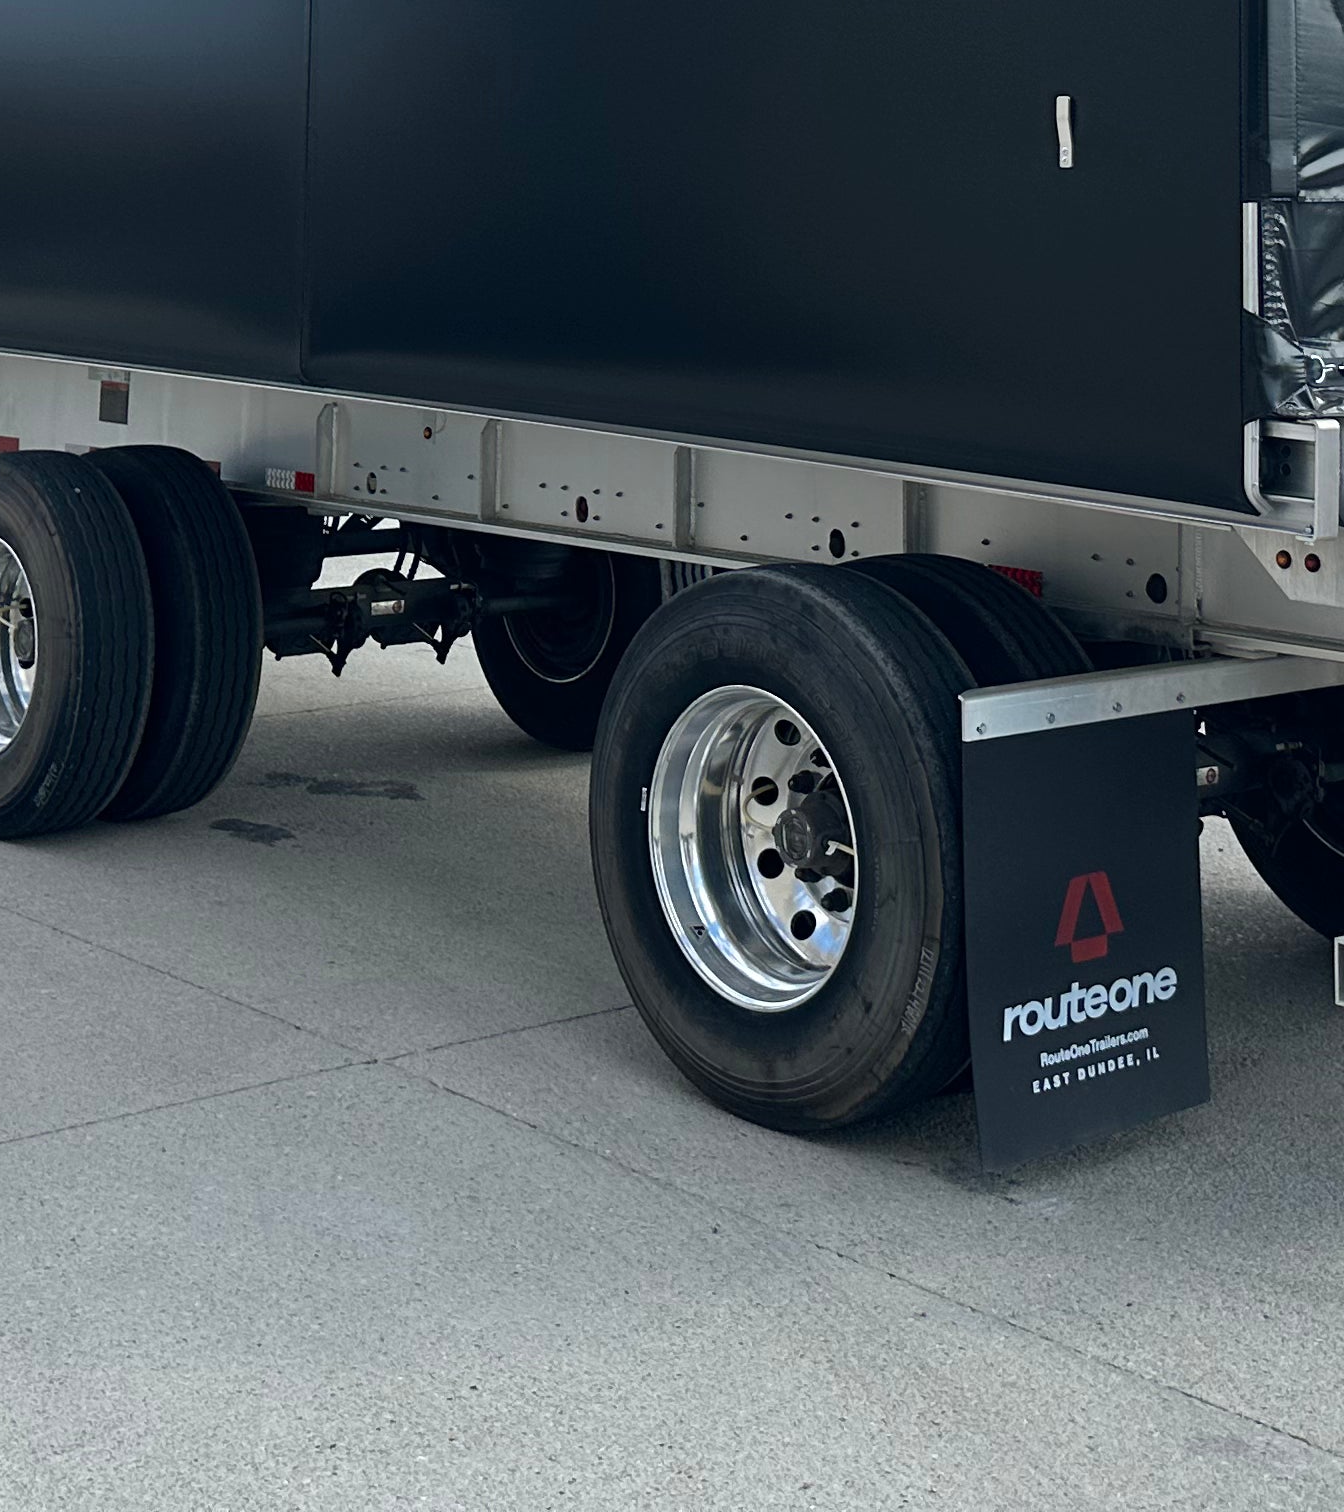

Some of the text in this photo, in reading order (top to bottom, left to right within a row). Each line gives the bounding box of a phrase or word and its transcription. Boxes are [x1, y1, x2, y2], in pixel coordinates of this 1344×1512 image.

[1003, 966, 1178, 1042] routeone
[1032, 1046, 1160, 1094] EAST DUNDEE, IL
[1040, 1027, 1149, 1068] RouteOneTrailers.com
